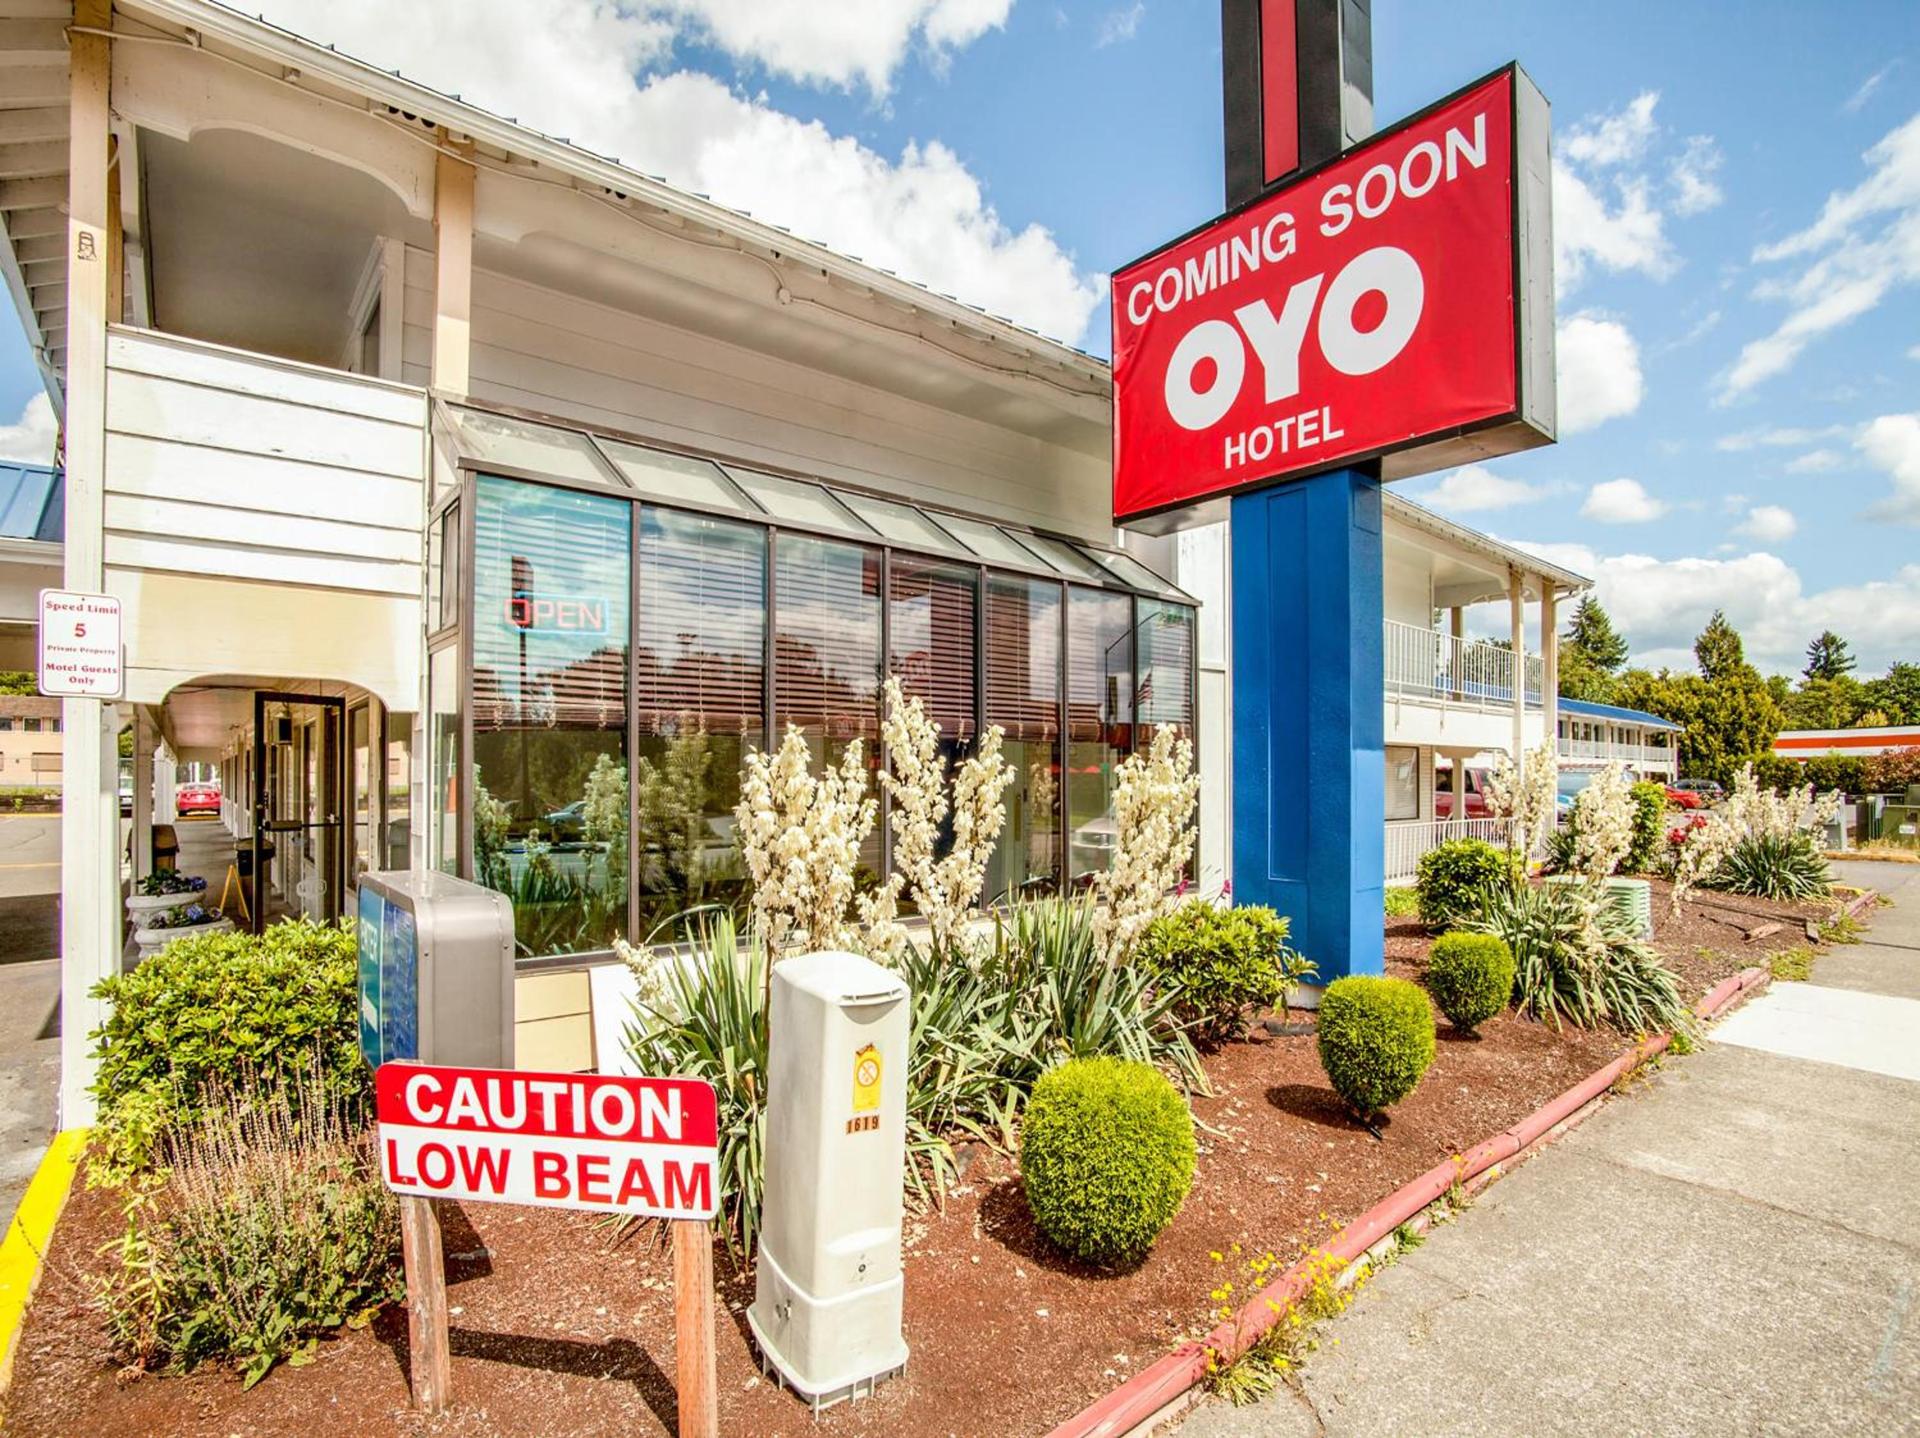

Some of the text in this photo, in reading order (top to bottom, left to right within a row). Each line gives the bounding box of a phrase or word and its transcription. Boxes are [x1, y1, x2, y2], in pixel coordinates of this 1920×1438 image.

[1127, 112, 1487, 326] COMING SOON
[1164, 246, 1425, 431] OYO
[1224, 406, 1344, 469] HOTEL
[45, 601, 118, 614] Speed Limit
[504, 598, 602, 629] OPEN
[74, 623, 86, 637] 5
[80, 647, 115, 655] Property
[46, 663, 118, 673] Motel Guests
[69, 676, 95, 685] Only
[405, 1073, 683, 1140] CAUTION
[847, 1115, 879, 1134] 1619
[387, 1139, 714, 1211] LOW BEAM
